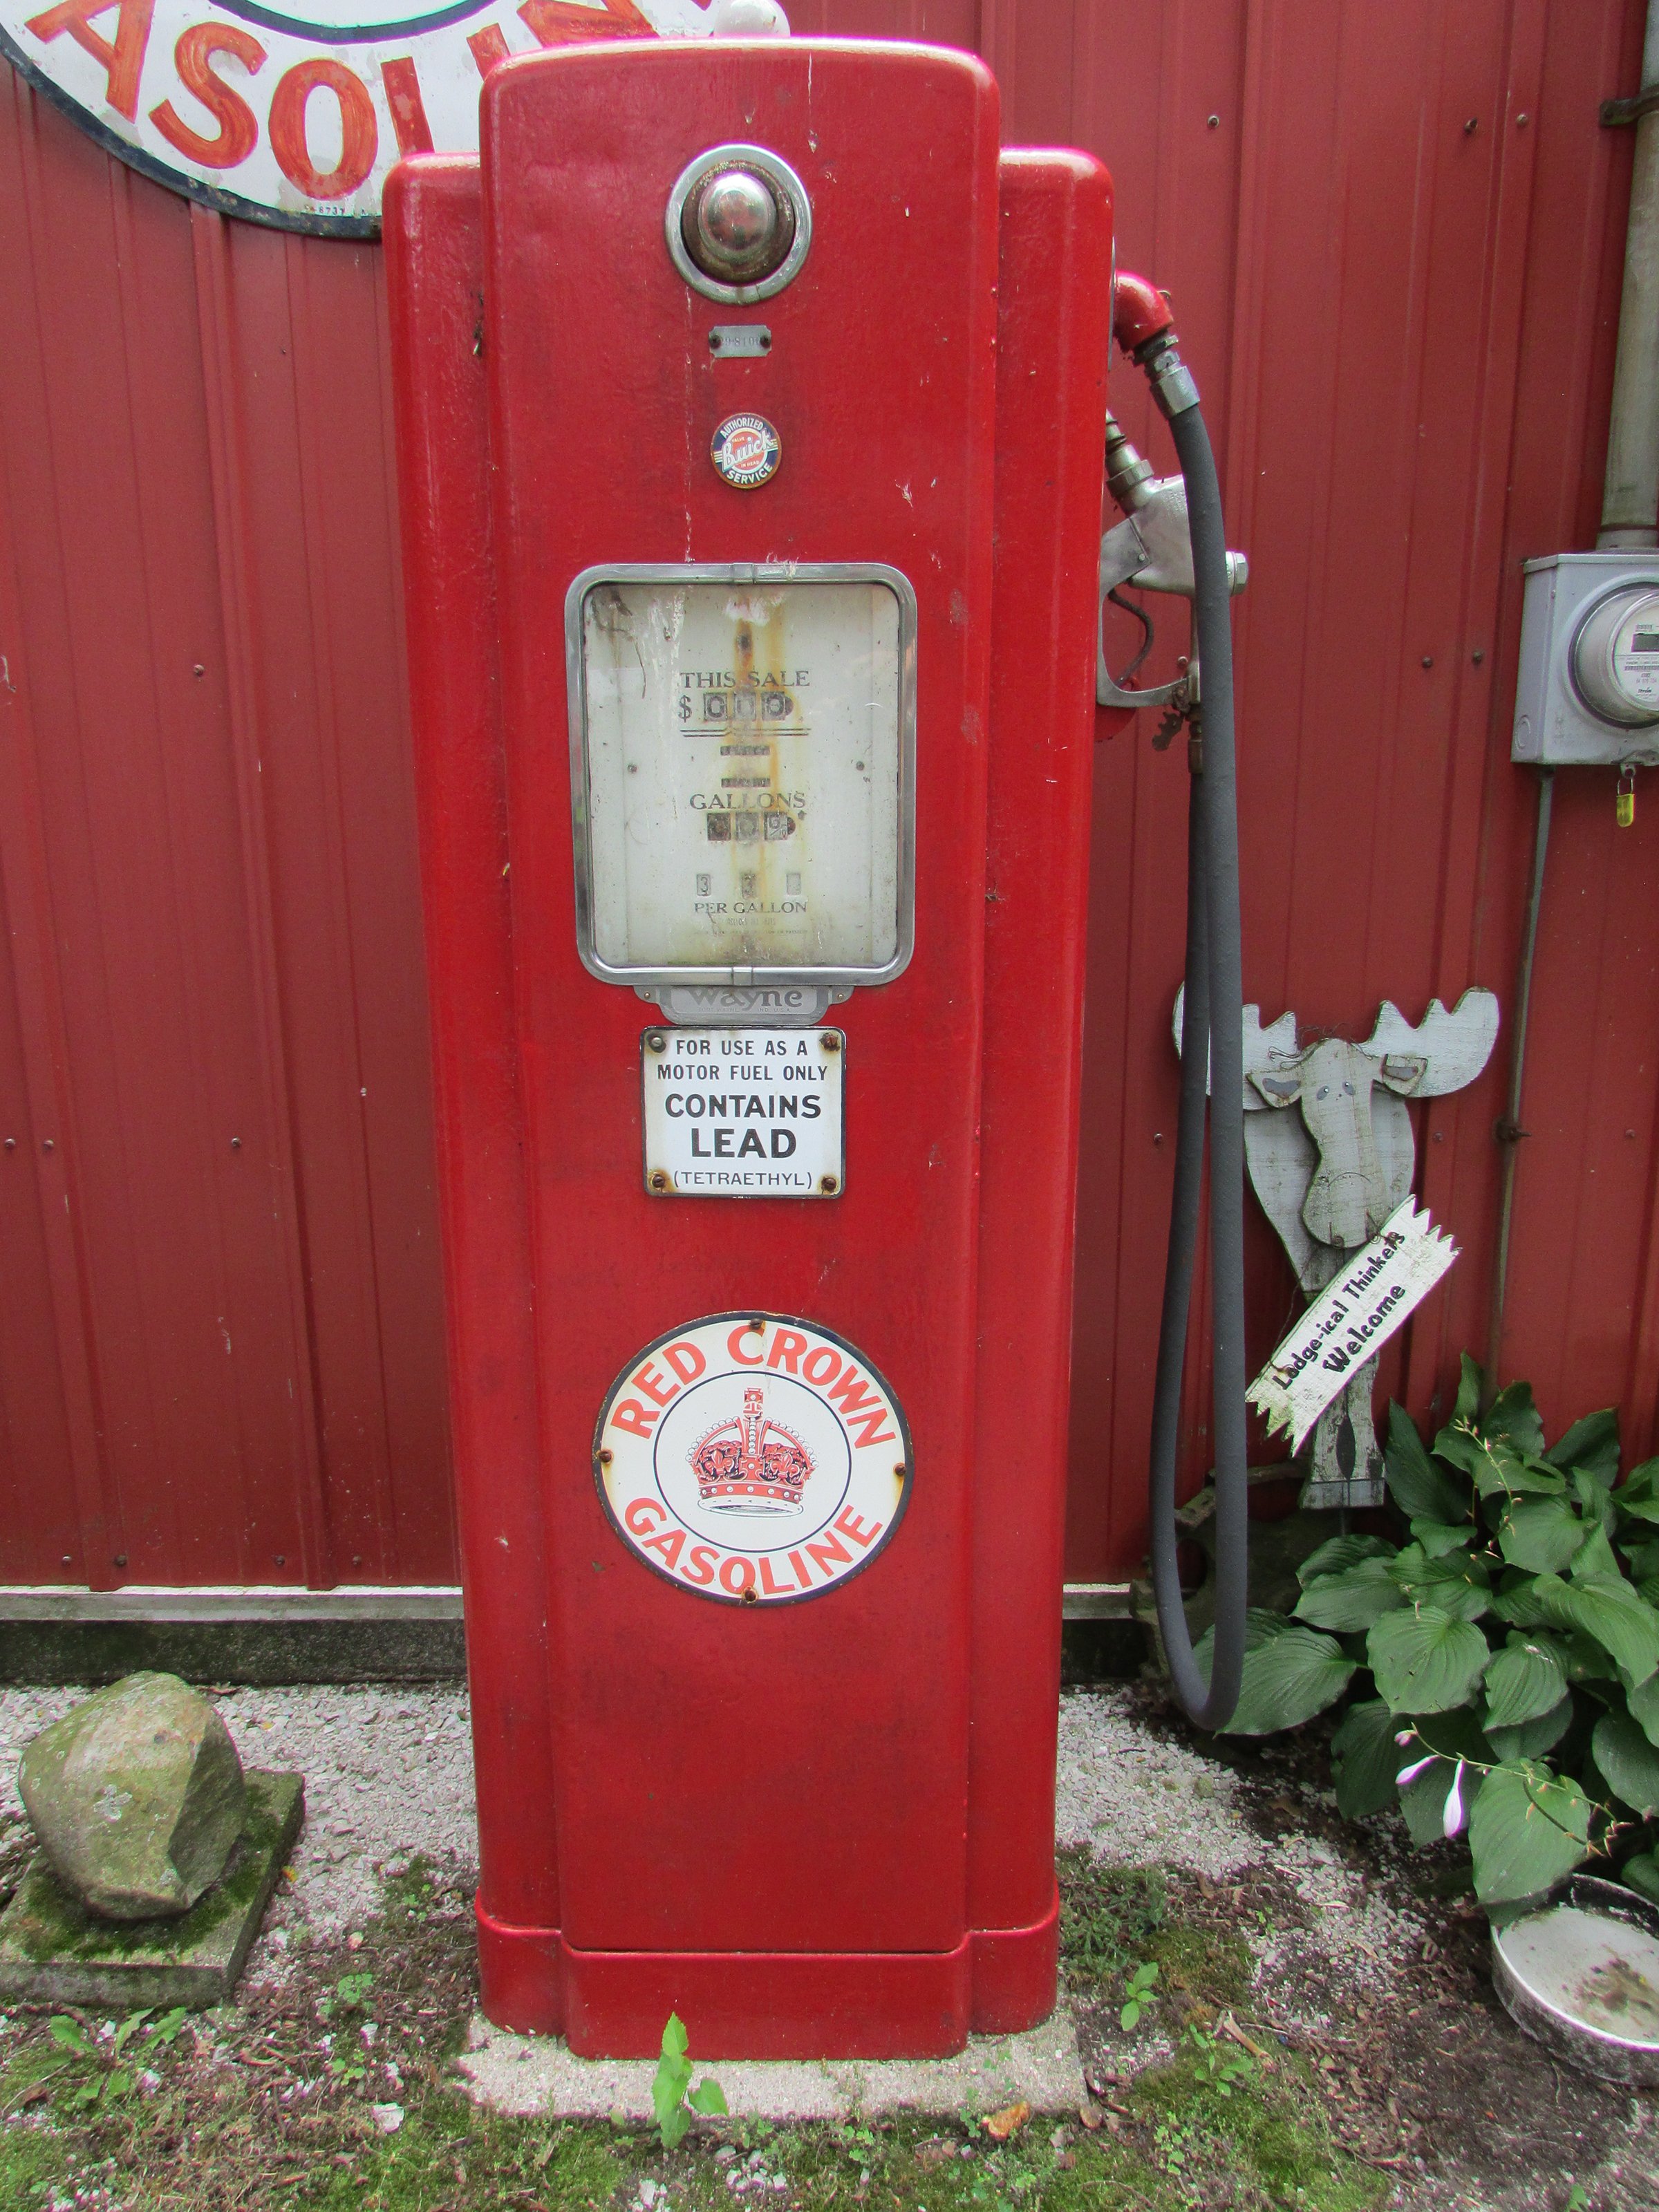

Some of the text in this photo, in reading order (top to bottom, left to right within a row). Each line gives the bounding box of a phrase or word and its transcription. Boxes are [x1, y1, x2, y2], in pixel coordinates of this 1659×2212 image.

[720, 418, 764, 440] AUTHORIZED
[722, 428, 773, 473] Buick
[727, 462, 773, 485] SERVICE
[680, 670, 810, 688] THIS SALE
[677, 695, 691, 722] $
[690, 793, 806, 809] GALLONS
[695, 902, 807, 913] PER GALLON
[688, 987, 803, 1011] Wayne
[676, 1040, 807, 1056] FOR USE AS A
[657, 1065, 827, 1080] MOTOR FUEL ONLY
[665, 1094, 821, 1118] CONTAINS
[691, 1128, 796, 1159] LEAD
[673, 1170, 812, 1189] (TETRAETHYL)
[1322, 1284, 1406, 1373] Welcome
[611, 1325, 897, 1449] RED CROWN
[624, 1497, 883, 1595] GASOLINE
